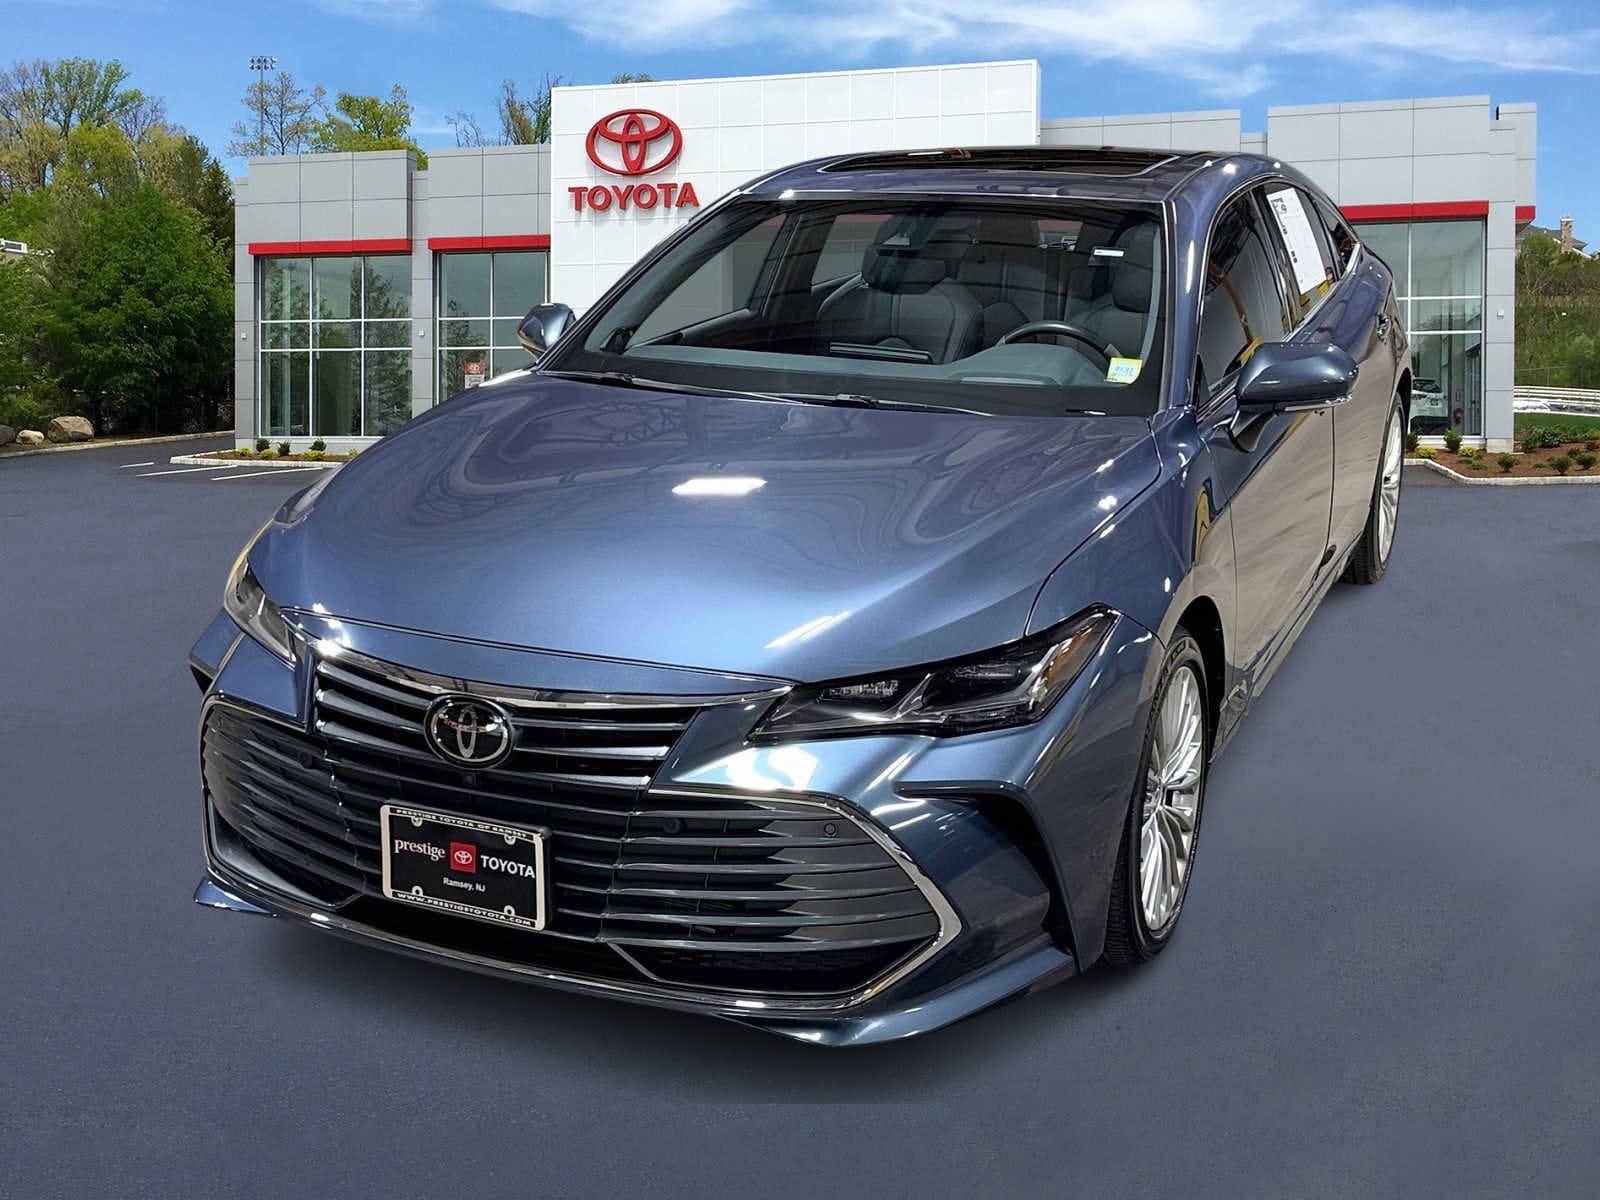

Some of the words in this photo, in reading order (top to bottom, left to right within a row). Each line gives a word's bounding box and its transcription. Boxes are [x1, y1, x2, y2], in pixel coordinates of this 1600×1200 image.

[568, 182, 700, 211] TOYOTA
[439, 816, 474, 828] TOYOTA
[394, 839, 446, 862] prestige
[480, 855, 536, 879] TOYOTA
[443, 877, 475, 891] Ramsey,
[475, 883, 486, 892] NJ
